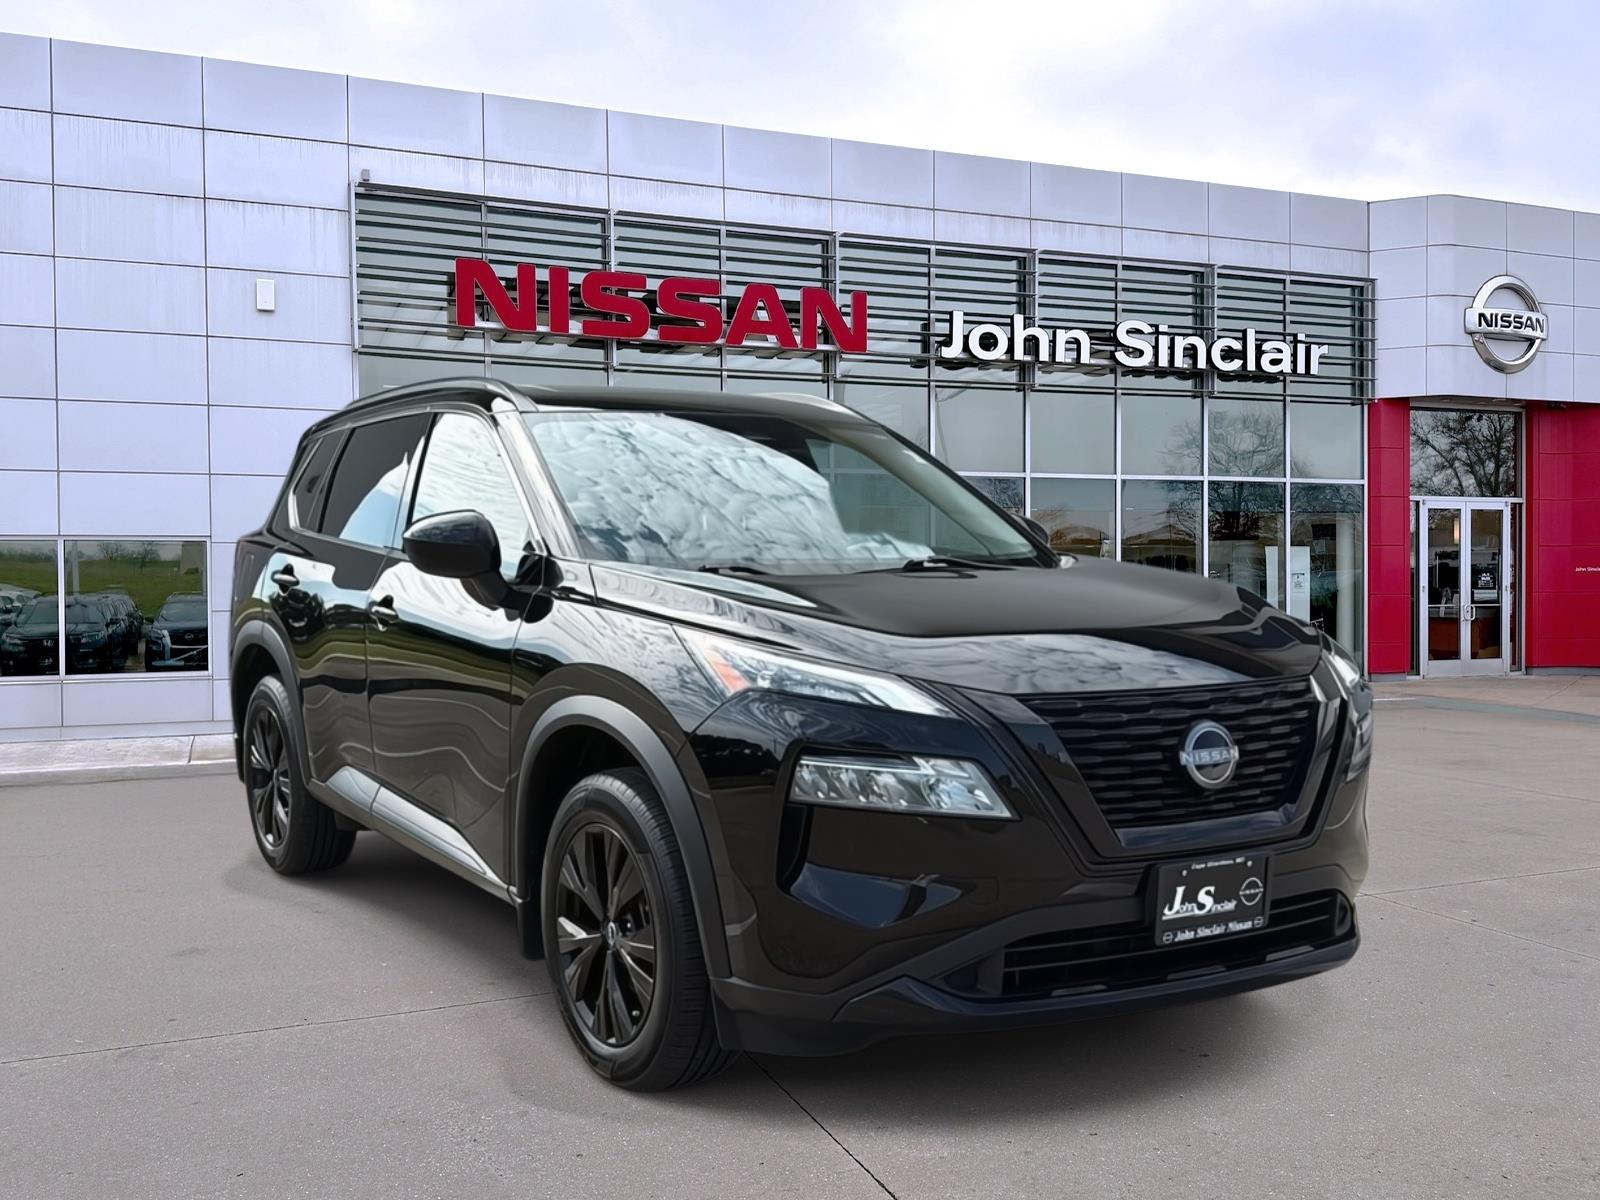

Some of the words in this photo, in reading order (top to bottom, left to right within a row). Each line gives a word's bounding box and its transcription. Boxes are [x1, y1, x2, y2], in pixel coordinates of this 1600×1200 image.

[455, 257, 868, 353] NISSAN
[1478, 312, 1545, 333] NISSAN
[940, 310, 1091, 364] John
[1114, 319, 1329, 375] Sinclair
[1174, 930, 1196, 942] John
[1196, 924, 1226, 938] Sinclair
